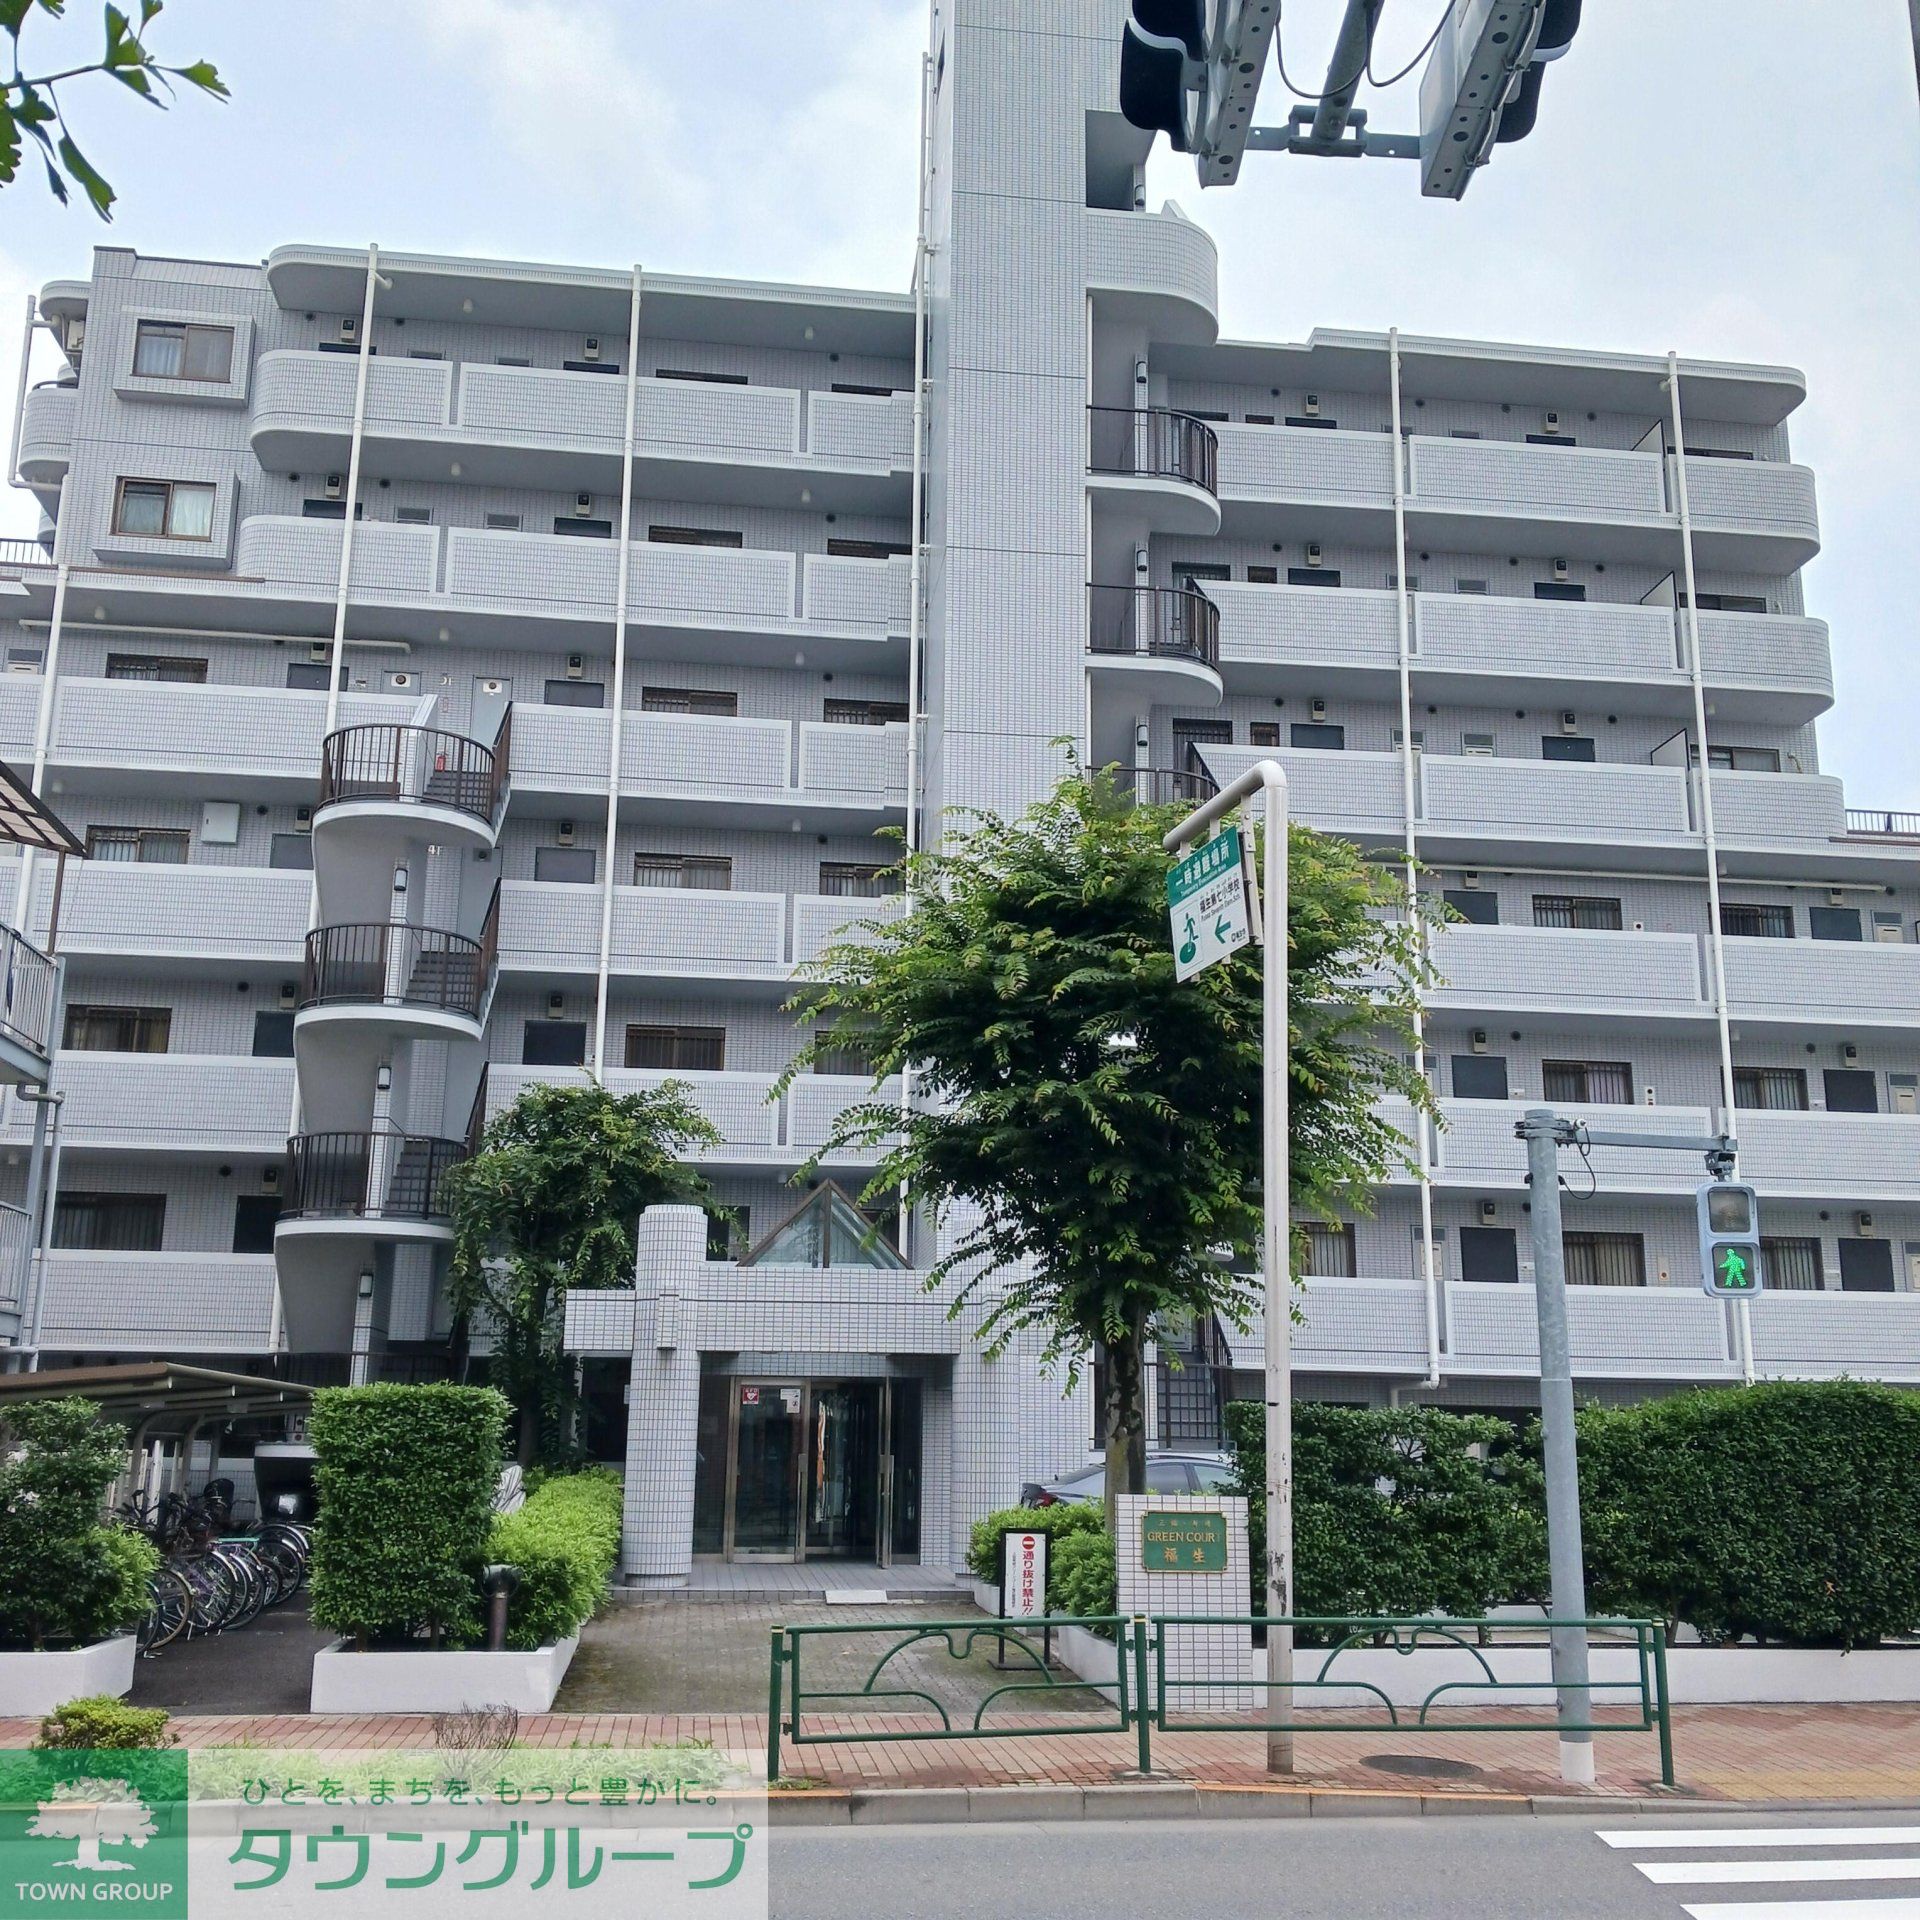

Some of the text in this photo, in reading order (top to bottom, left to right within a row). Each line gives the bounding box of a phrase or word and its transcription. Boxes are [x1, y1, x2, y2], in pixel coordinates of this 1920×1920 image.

[1175, 840, 1229, 886] 一時避難場所
[1147, 1531, 1184, 1543] GREEN
